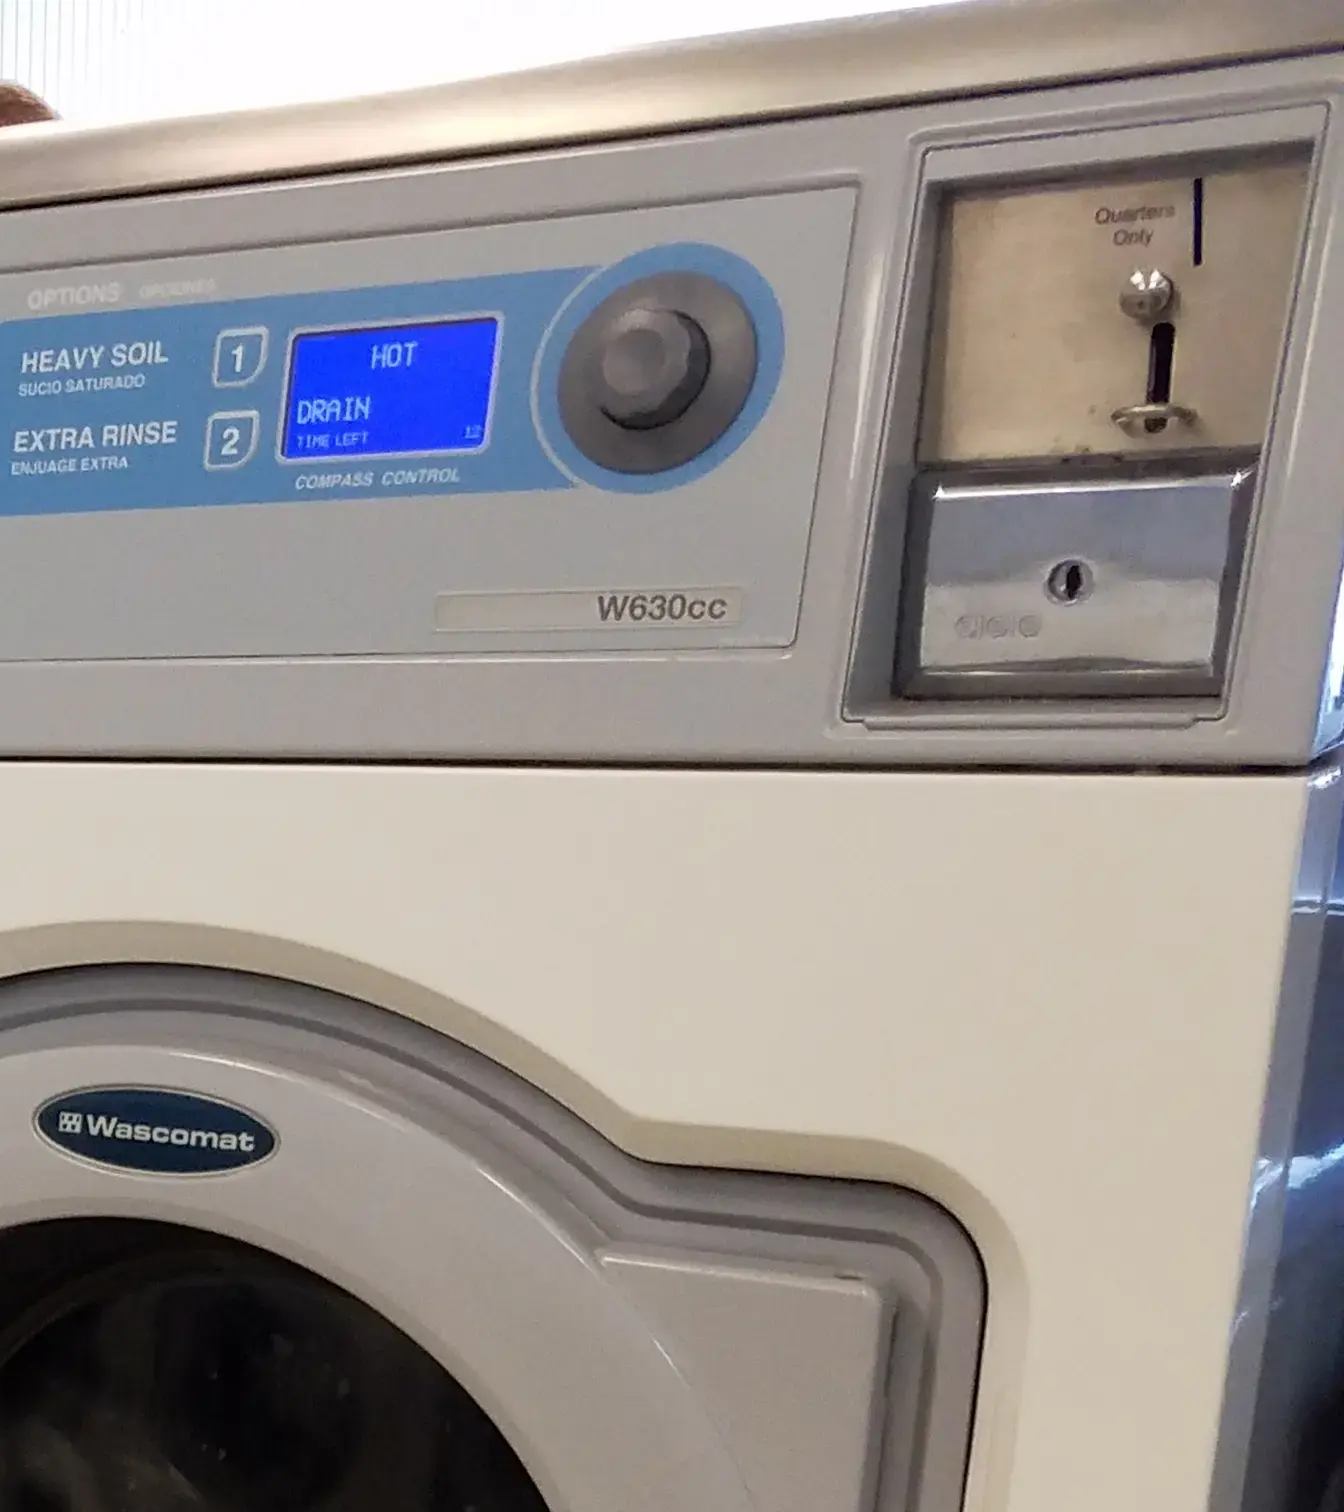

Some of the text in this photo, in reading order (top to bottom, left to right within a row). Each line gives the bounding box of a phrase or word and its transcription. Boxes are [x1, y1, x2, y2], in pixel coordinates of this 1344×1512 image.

[1095, 205, 1175, 225] Quarters
[1113, 229, 1154, 247] Only
[27, 281, 120, 311] OPTIONS
[20, 340, 169, 374] HEAVY SOIL
[231, 343, 244, 373] 1
[370, 341, 418, 370] HOT
[17, 373, 146, 397] SUCIO SATURADO
[296, 395, 371, 424] DRAIN
[12, 420, 178, 453] EXTRA RINSE
[220, 426, 240, 456] 2
[297, 431, 369, 449] TIME LEFT
[11, 455, 128, 476] ENJUAGE EXTRA
[295, 467, 461, 490] COMPASS CONTROL
[596, 593, 728, 622] W630cc
[86, 1113, 255, 1152] Wascomat
